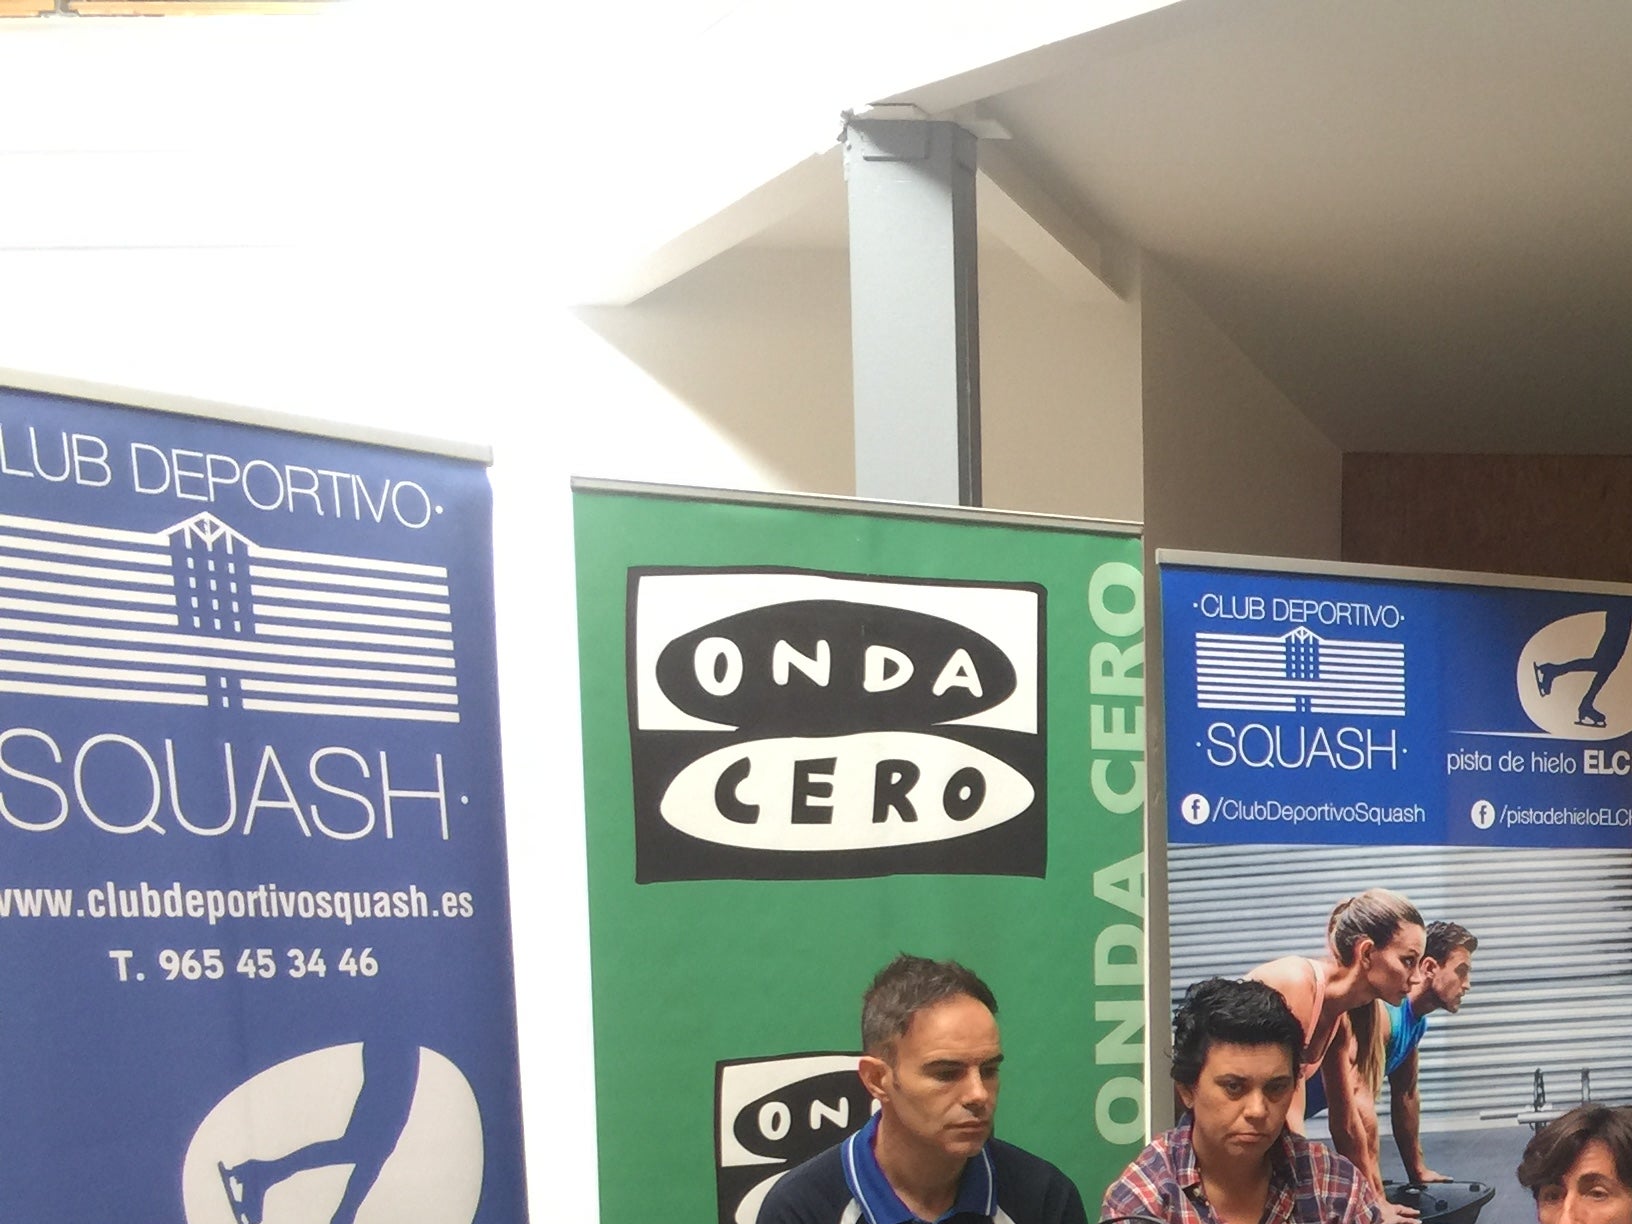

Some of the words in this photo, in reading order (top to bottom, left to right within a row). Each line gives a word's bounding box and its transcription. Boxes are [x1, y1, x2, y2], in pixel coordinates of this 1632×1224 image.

[0, 422, 111, 487] LUB
[131, 442, 432, 529] DEPORTIVO
[1200, 593, 1266, 620] CLUB
[1273, 599, 1399, 628] DEPORTIVO
[693, 636, 985, 698] ONDA
[1088, 560, 1147, 815] CERO
[1206, 721, 1398, 771] SQUASH
[1447, 748, 1493, 776] pista
[1499, 749, 1525, 774] de
[1531, 749, 1577, 775] hielo
[0, 727, 450, 841] SQUASH
[714, 755, 988, 825] CERO
[1212, 800, 1426, 827] /ClubDeportivoSquash
[110, 950, 146, 982] T.
[159, 949, 224, 981] 965
[237, 949, 277, 980] 45
[288, 948, 327, 978] 34
[339, 947, 379, 977] 46
[1093, 853, 1147, 1145] ONDA
[758, 1097, 880, 1141] ON
